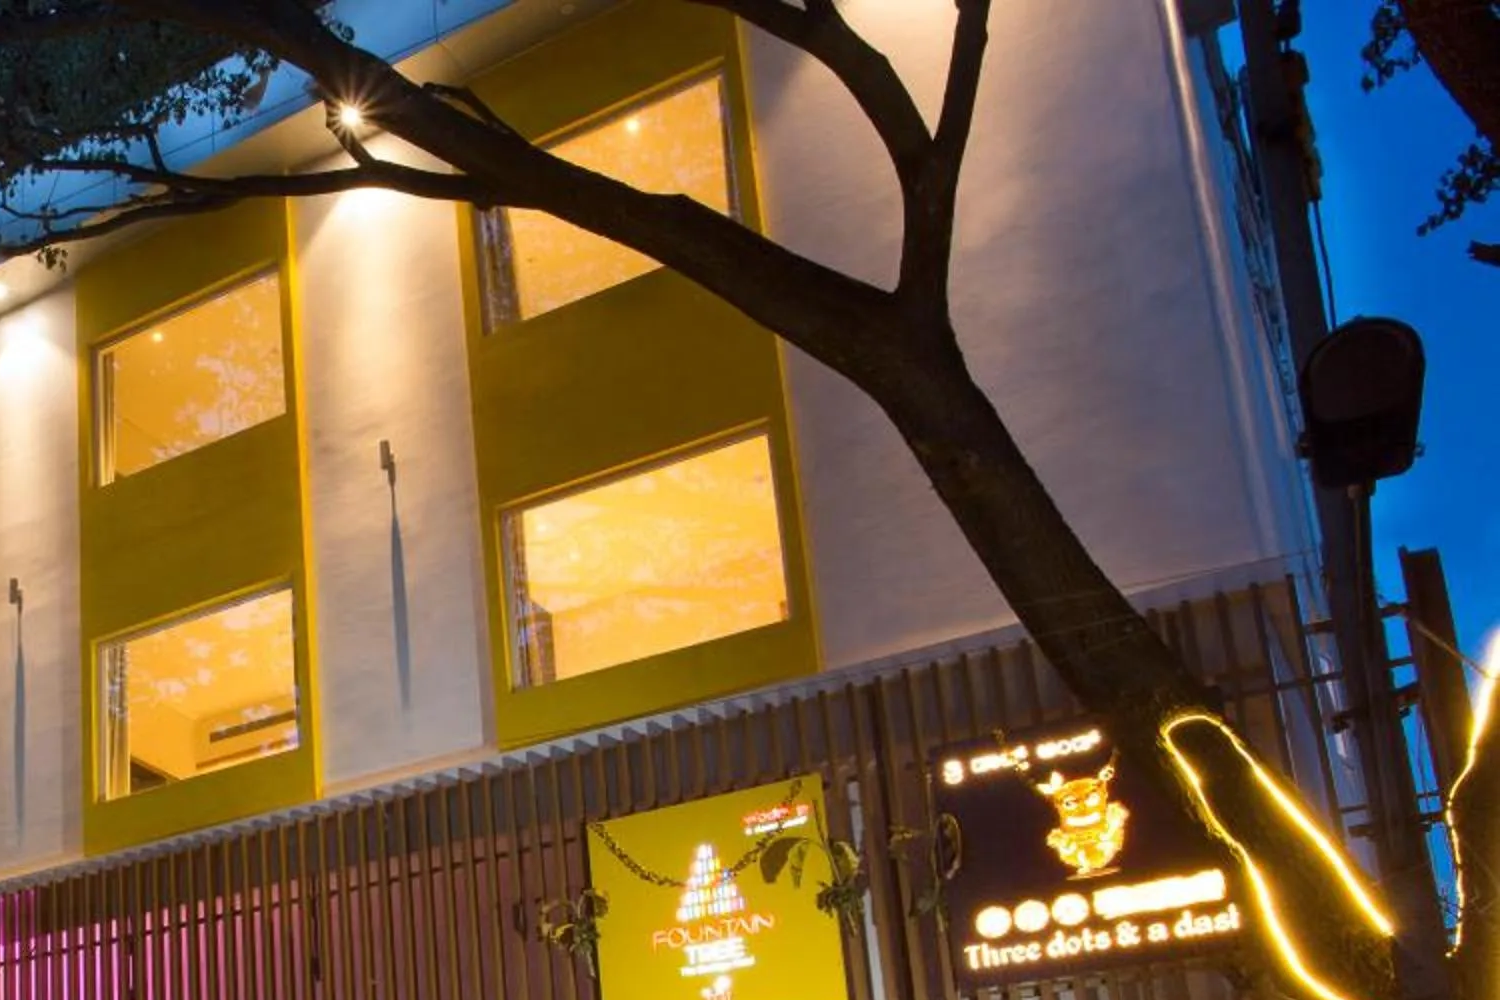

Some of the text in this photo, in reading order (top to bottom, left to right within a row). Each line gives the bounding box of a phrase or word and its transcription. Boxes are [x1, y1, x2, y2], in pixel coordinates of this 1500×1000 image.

[652, 913, 775, 953] FOUNTAIN
[964, 941, 1043, 971] Three
[1046, 927, 1111, 958] dots
[1116, 920, 1142, 947] &
[1148, 919, 1169, 943] a
